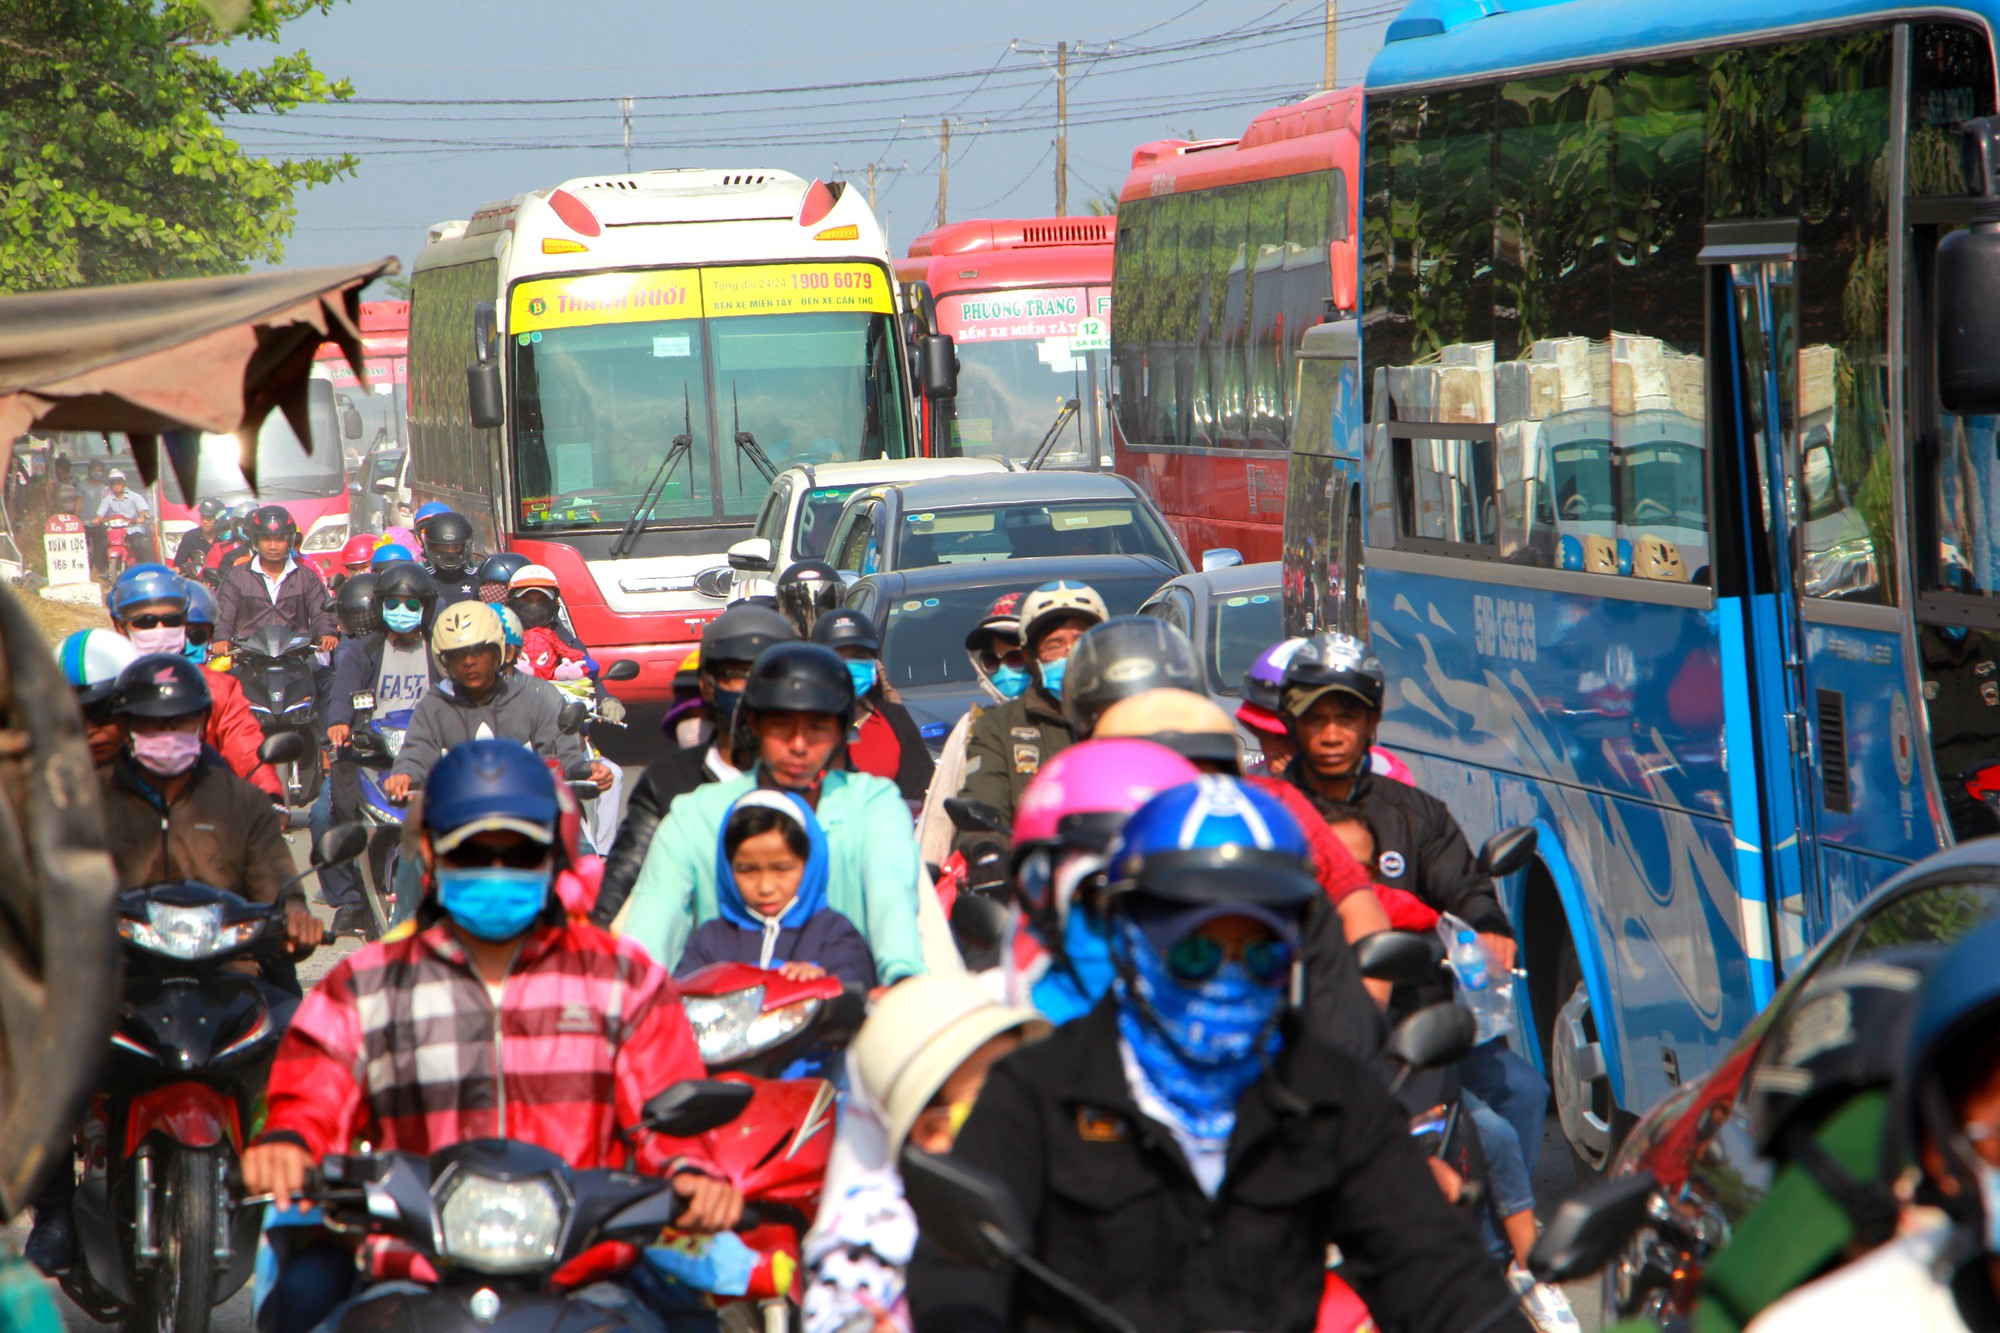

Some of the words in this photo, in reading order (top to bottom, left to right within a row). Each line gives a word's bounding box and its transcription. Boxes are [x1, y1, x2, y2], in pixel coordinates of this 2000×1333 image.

[791, 272, 829, 290] 1900
[833, 272, 872, 289] 6079
[736, 300, 746, 309] XE
[822, 296, 833, 305] XE
[1025, 297, 1077, 318] TRANG
[989, 325, 1008, 338] XE
[1083, 322, 1100, 335] 12
[380, 674, 426, 700] FAST
